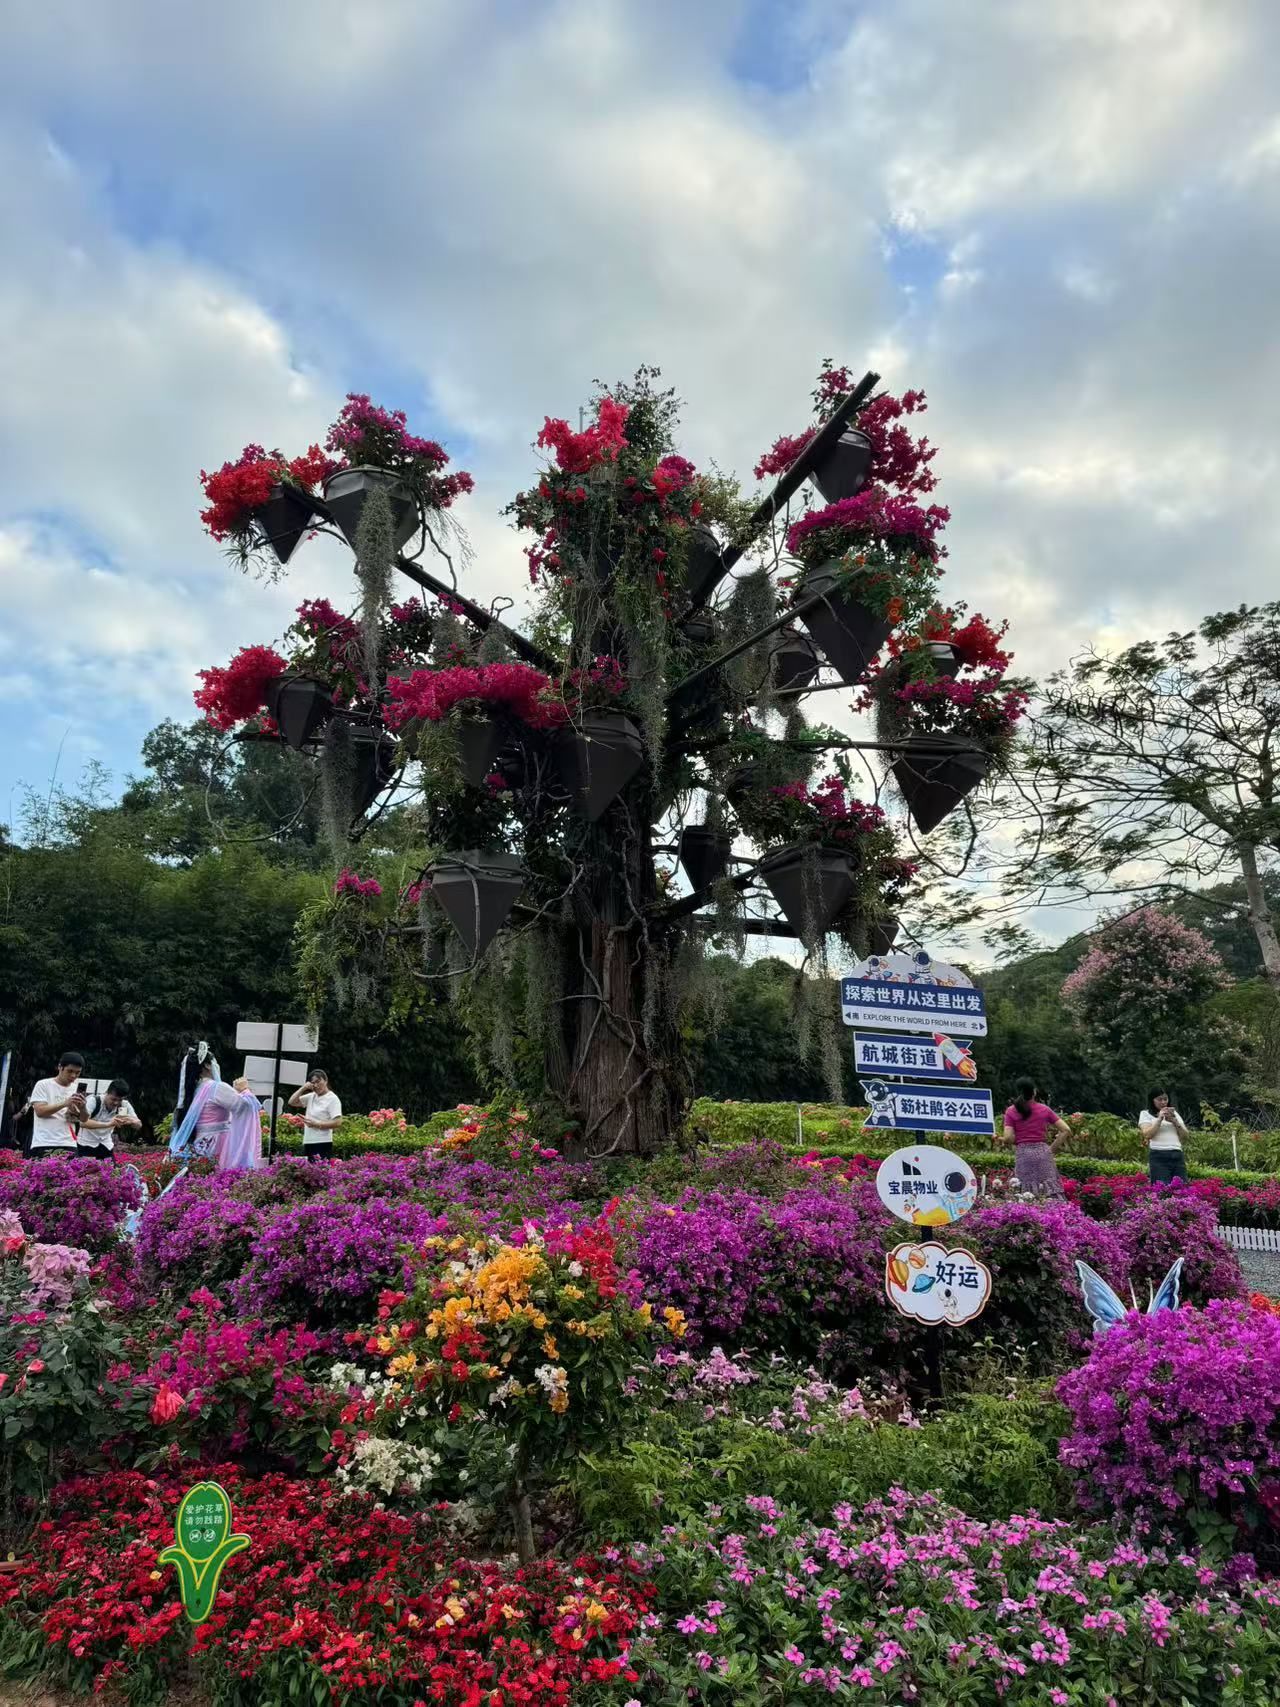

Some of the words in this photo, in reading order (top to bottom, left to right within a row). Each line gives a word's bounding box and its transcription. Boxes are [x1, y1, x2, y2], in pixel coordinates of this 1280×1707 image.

[845, 984, 982, 1012] 探索世界从这里出发
[863, 1013, 892, 1023] EXPLORE
[893, 1015, 906, 1024] THE
[906, 1016, 930, 1025] WORLD
[931, 1018, 950, 1027] FROM
[950, 1020, 967, 1028] HERE
[862, 1043, 938, 1067] 航城街道
[888, 1180, 939, 1195] 宝晨物业
[935, 1260, 979, 1289] 好运
[185, 1515, 223, 1525] 请勿践踏
